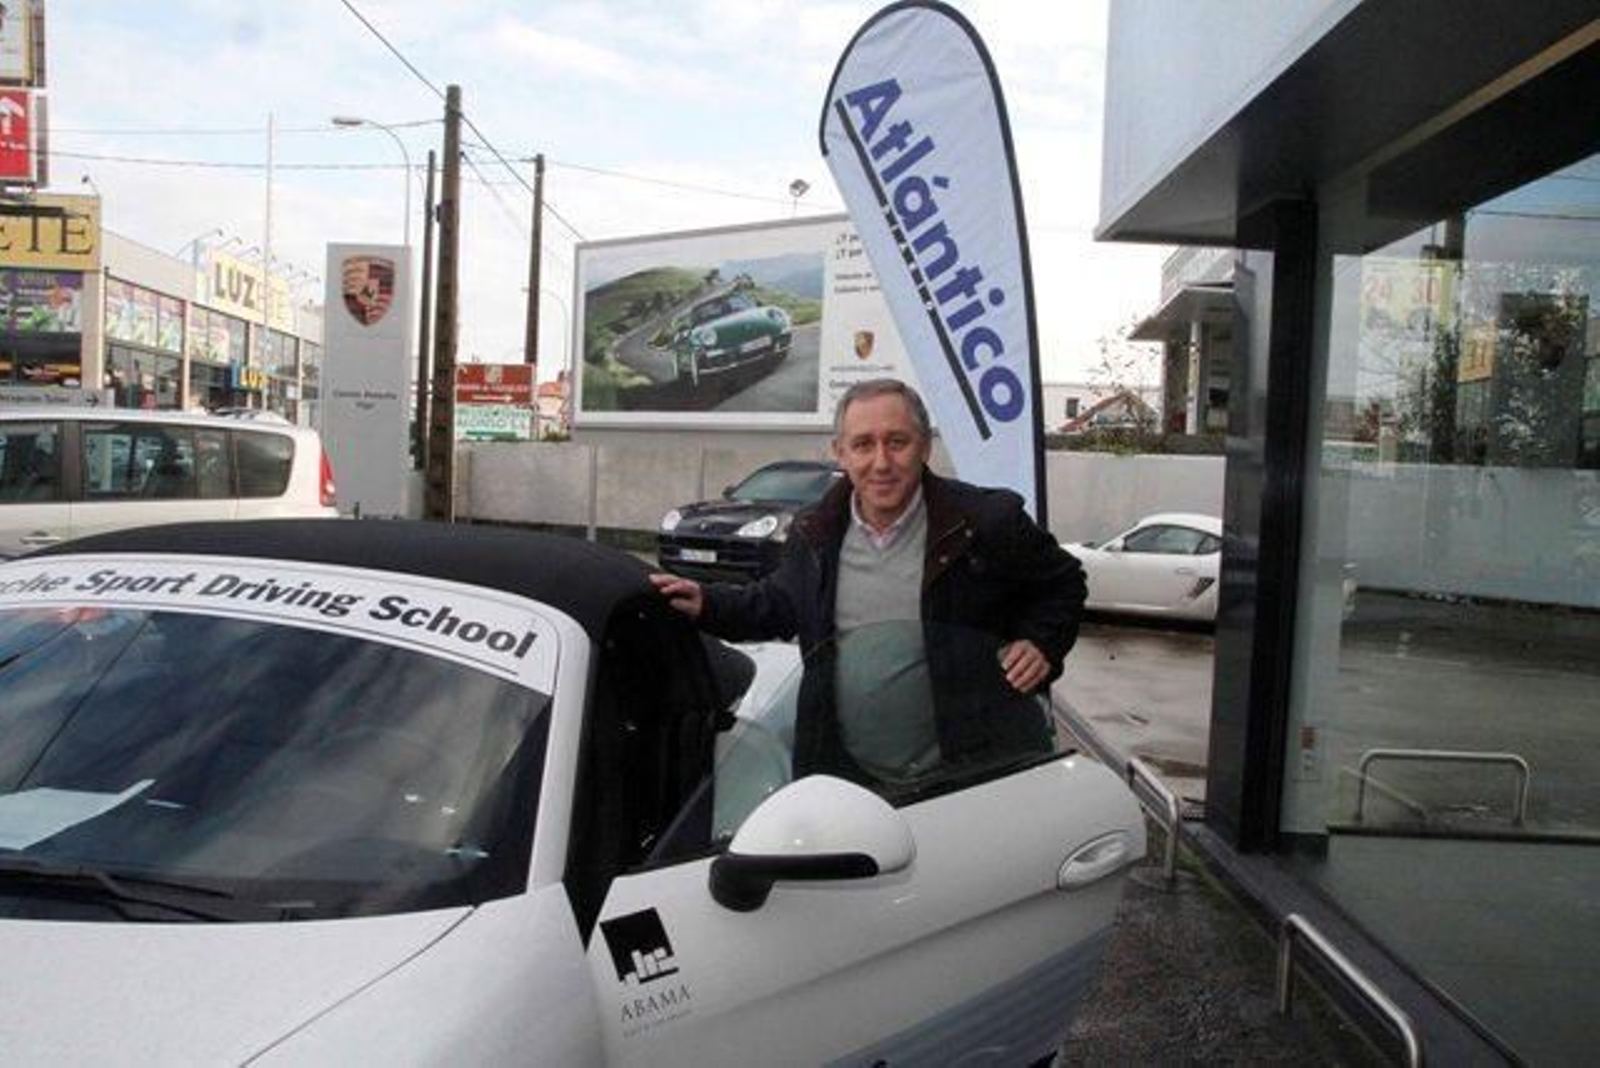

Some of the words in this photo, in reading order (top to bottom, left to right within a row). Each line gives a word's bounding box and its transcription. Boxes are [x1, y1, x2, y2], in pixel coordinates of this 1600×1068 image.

[844, 78, 1025, 423] Atlántico
[0, 571, 71, 594] che
[75, 570, 197, 595] Sport
[202, 574, 363, 617] Driving
[370, 595, 537, 658] School
[621, 984, 690, 1021] ABAMA
